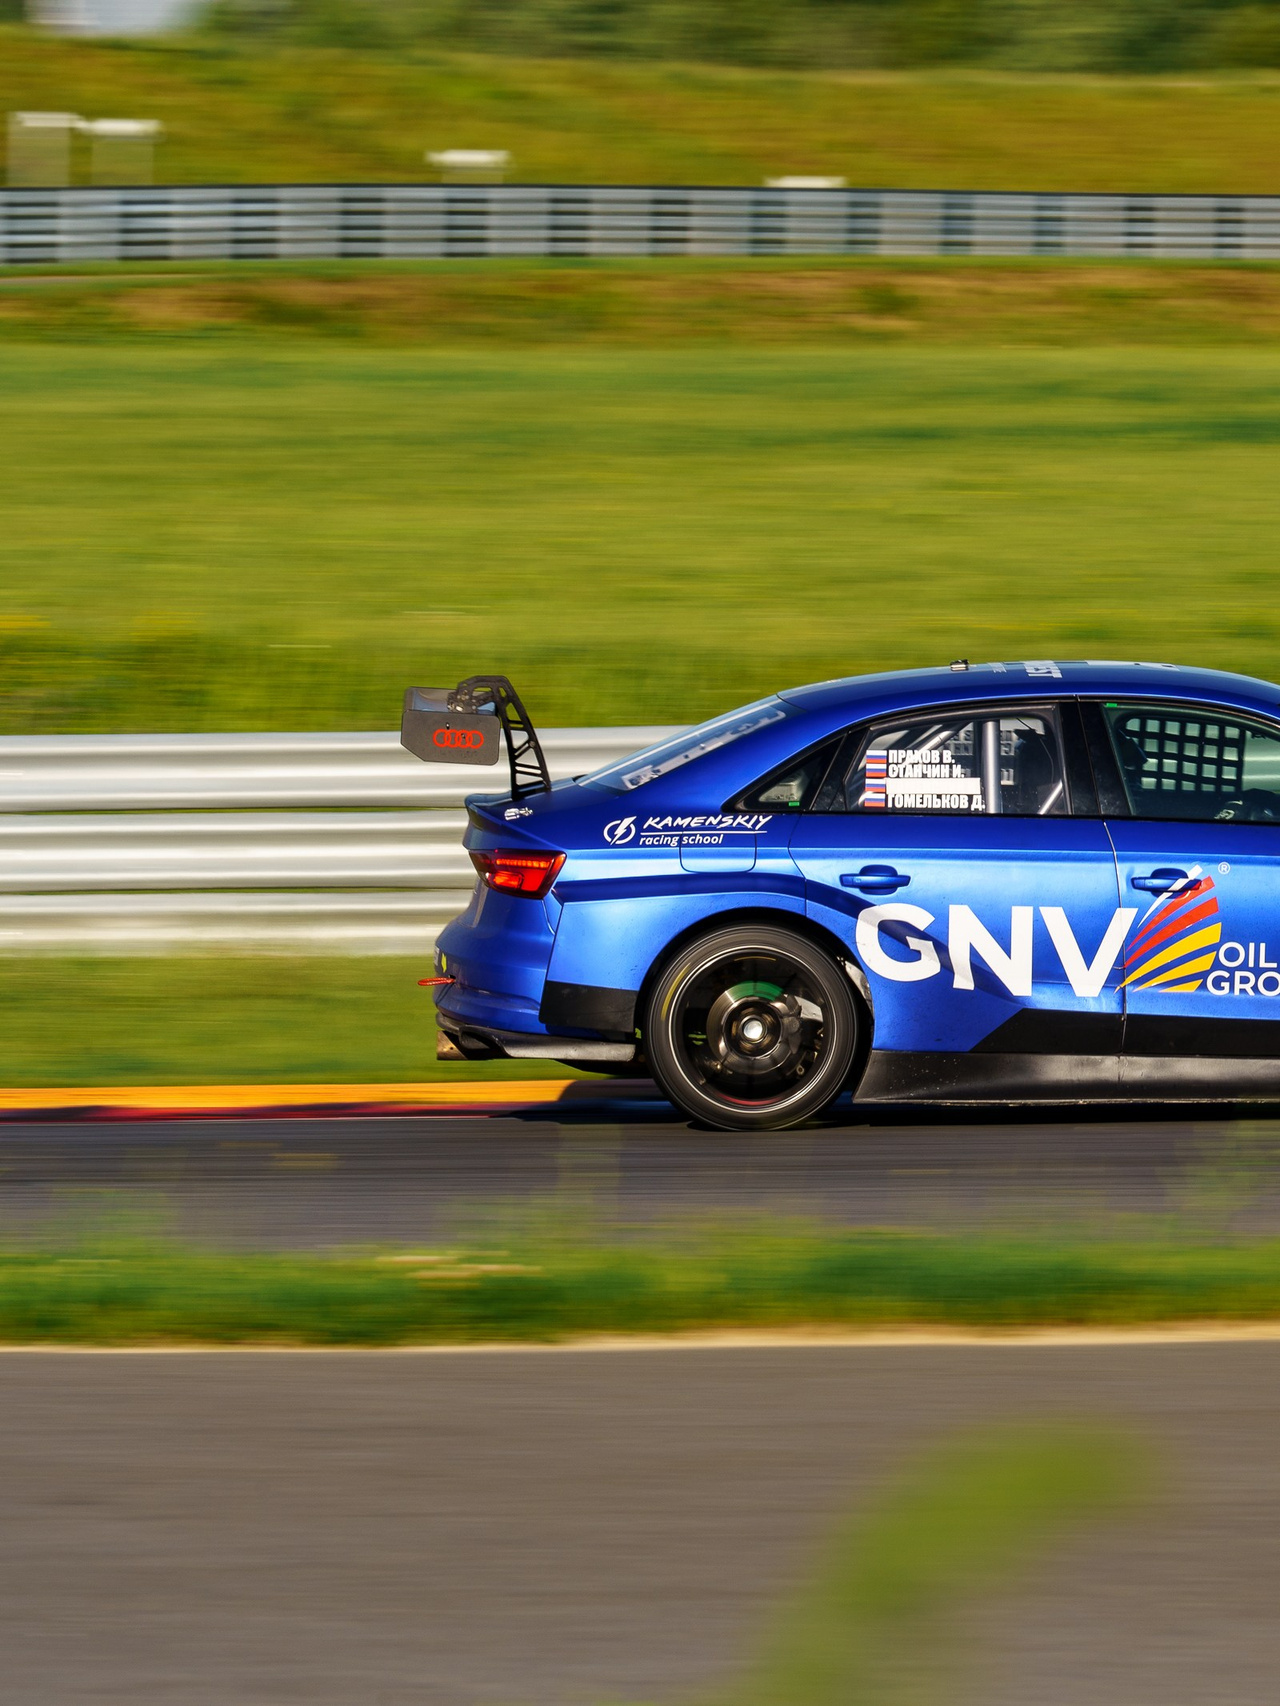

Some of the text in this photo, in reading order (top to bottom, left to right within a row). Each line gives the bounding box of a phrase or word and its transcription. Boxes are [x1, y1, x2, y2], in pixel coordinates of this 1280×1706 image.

[942, 749, 955, 764] В.
[952, 764, 965, 778] И.
[643, 814, 773, 830] KAMENSKIY
[639, 834, 724, 847] racing school
[855, 902, 1139, 998] GNV
[1218, 941, 1278, 968] OIL
